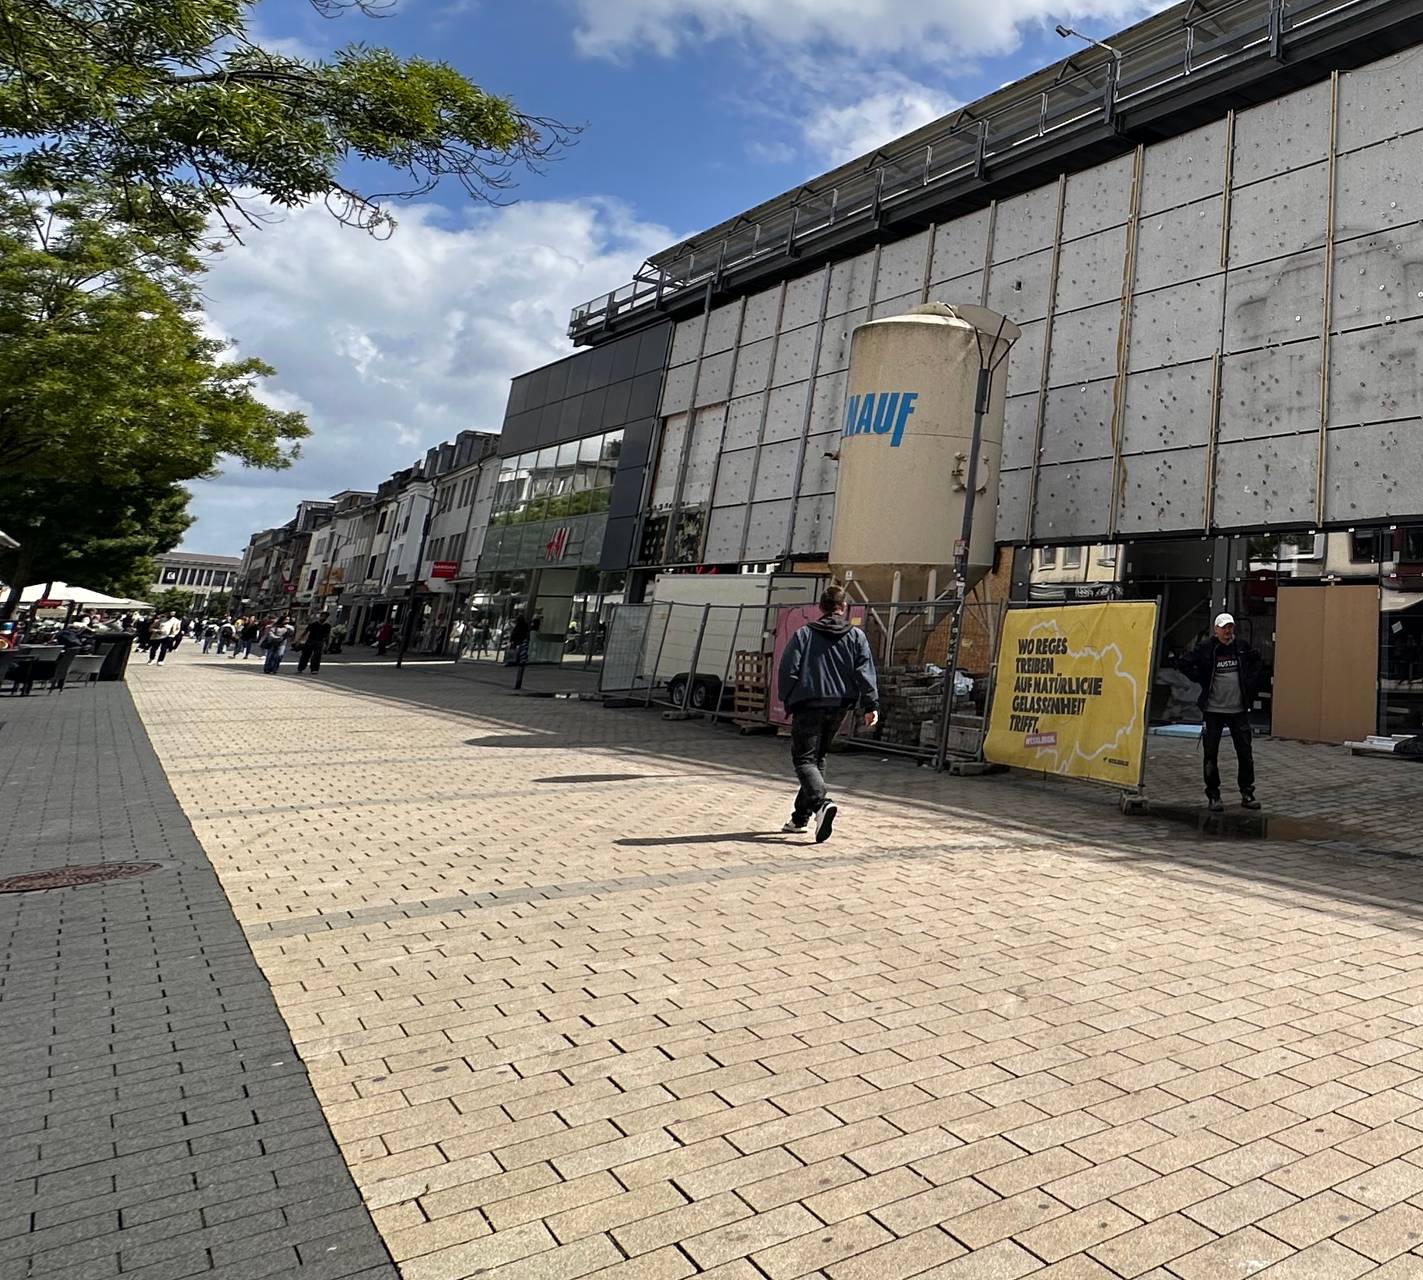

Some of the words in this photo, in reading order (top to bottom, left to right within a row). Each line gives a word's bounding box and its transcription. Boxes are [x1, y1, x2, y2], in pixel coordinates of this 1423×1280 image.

[844, 391, 918, 447] NAUF
[1018, 638, 1035, 655] WO
[1035, 637, 1068, 655] REGES
[1015, 657, 1054, 674] TREIBEN
[1013, 676, 1033, 694] AUF
[1012, 695, 1087, 716] GELASSENHEIT
[1009, 714, 1040, 734] TRIFFT.
